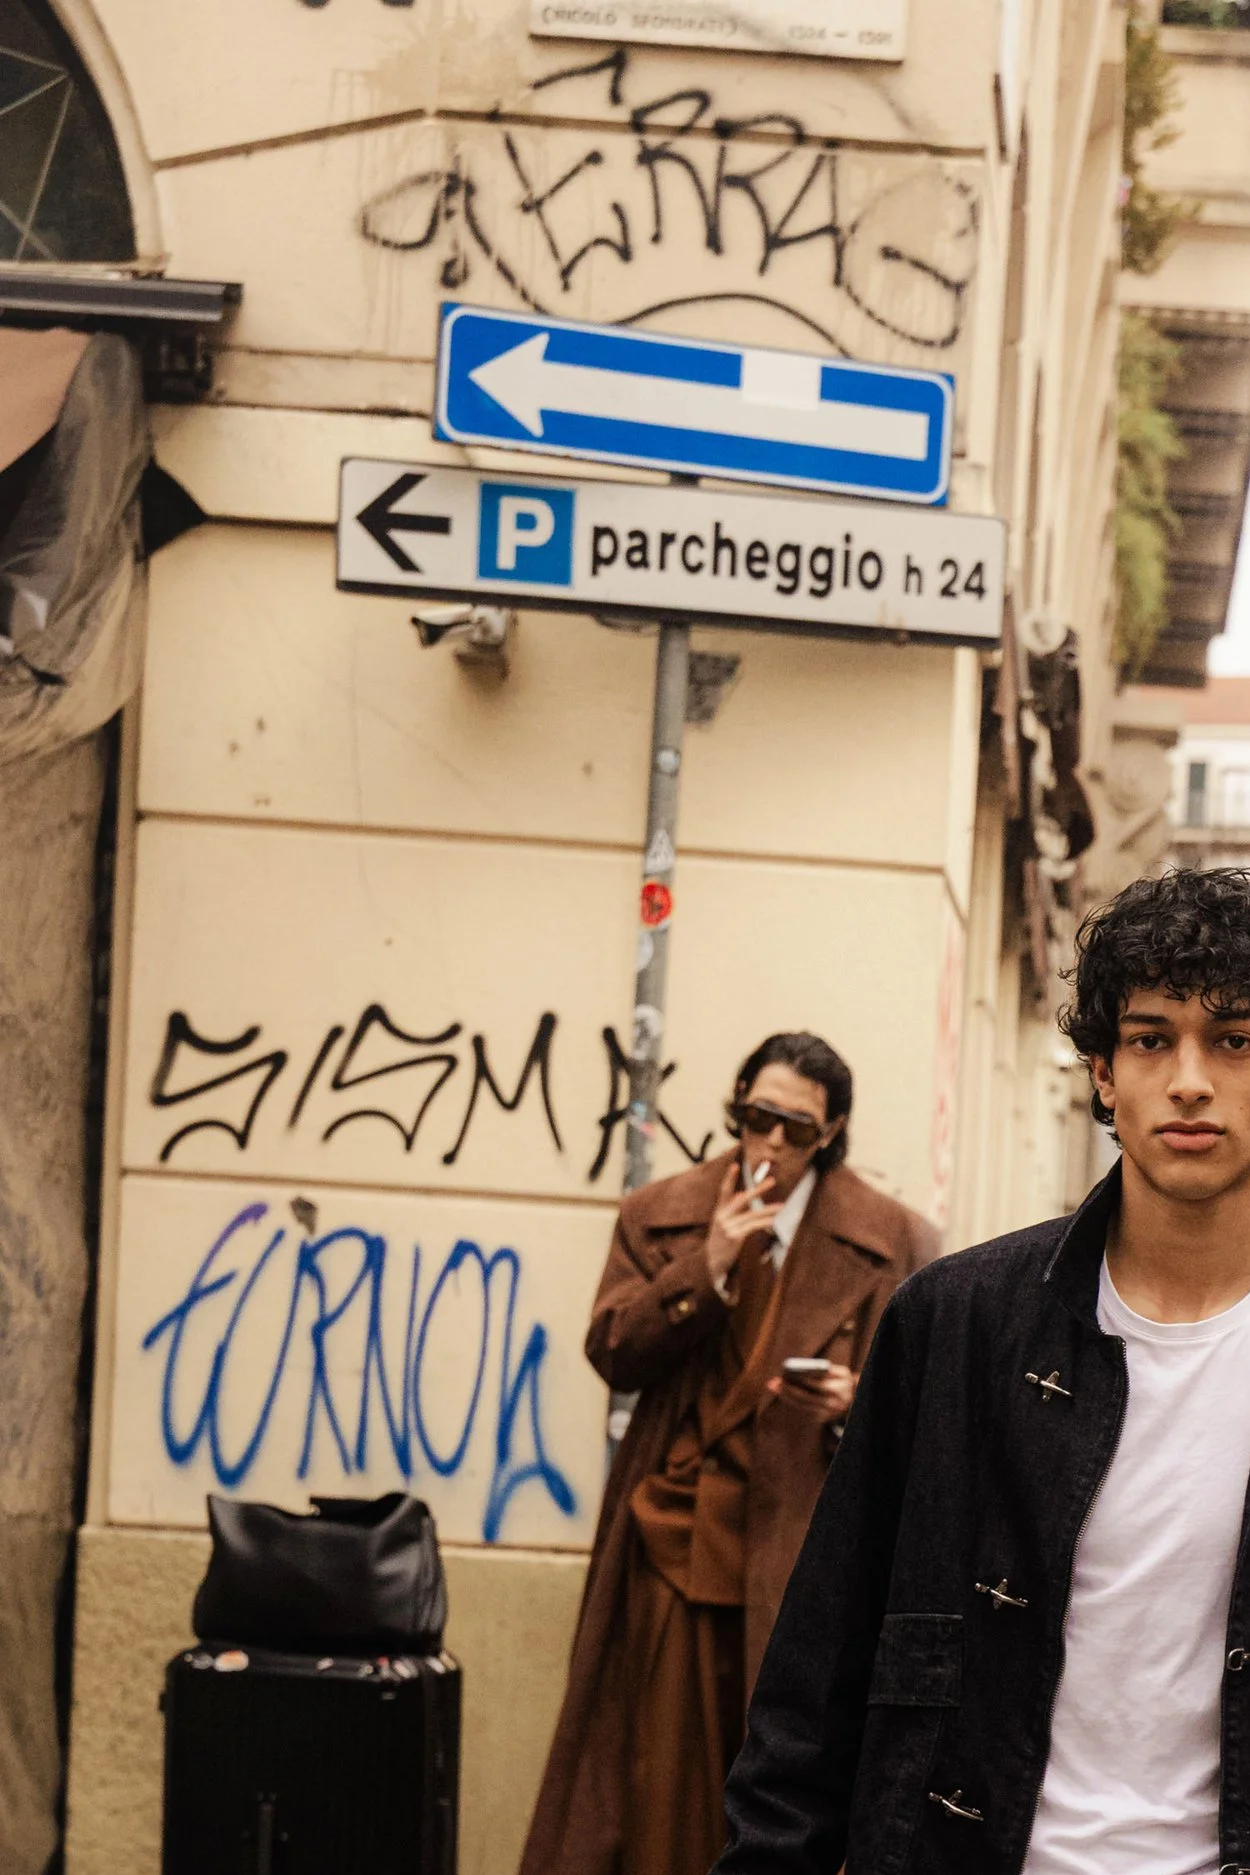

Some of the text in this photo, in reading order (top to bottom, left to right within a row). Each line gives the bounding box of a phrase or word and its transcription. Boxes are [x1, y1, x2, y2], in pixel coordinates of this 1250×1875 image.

[495, 495, 988, 600] P parcheggio h 24
